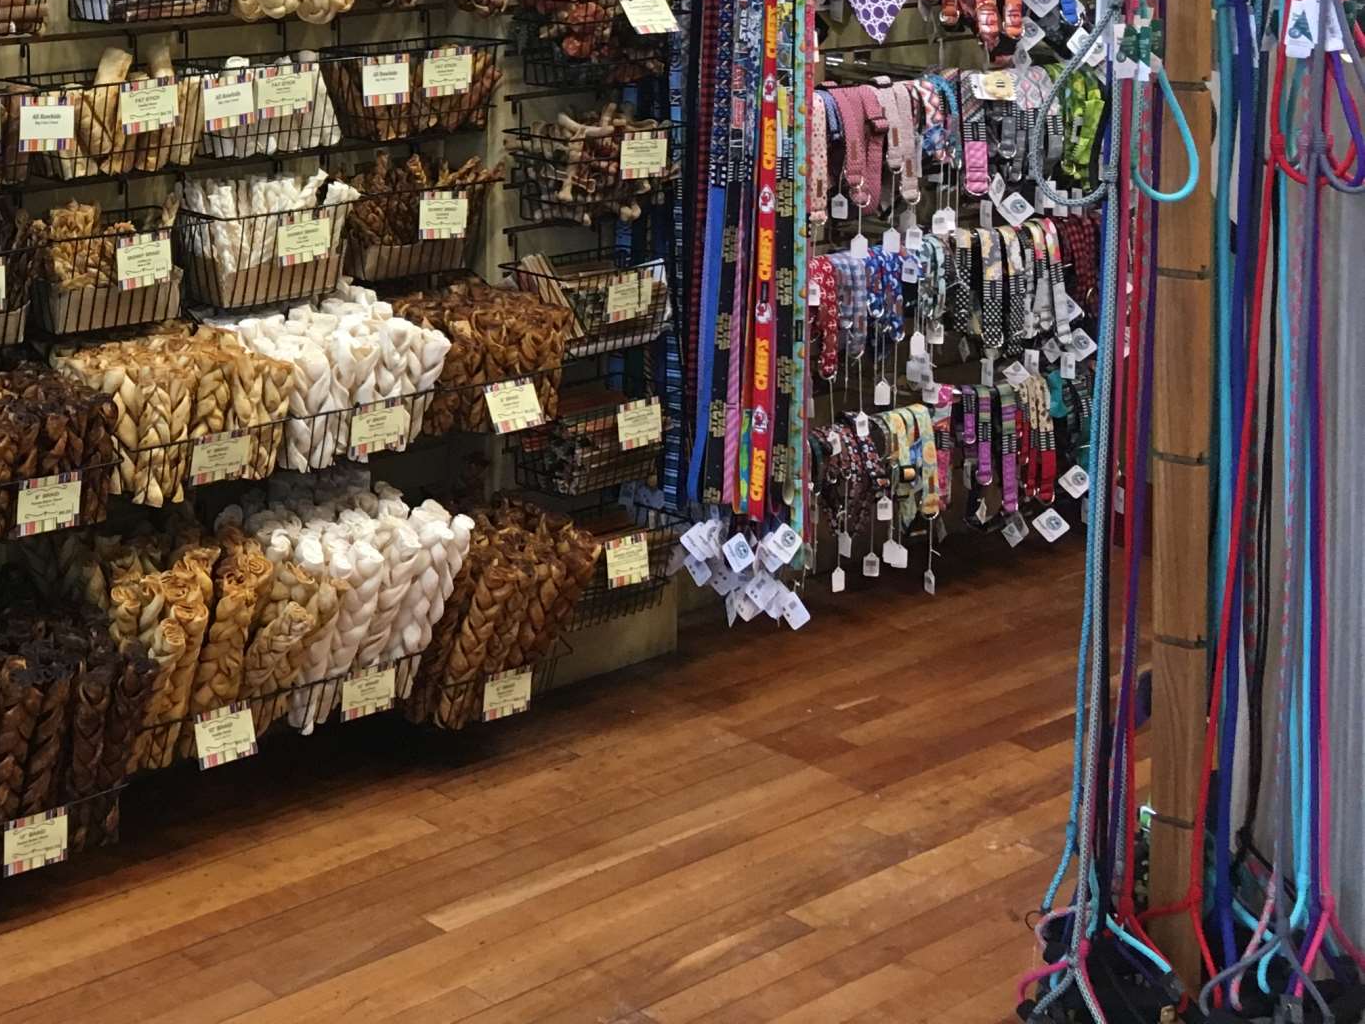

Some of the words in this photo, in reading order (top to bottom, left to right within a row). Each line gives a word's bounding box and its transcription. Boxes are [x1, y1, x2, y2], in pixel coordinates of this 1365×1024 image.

[765, 6, 776, 58] CHIEFS
[762, 117, 776, 170] CHIEFS
[757, 227, 773, 281] CHIEFS
[754, 337, 770, 391] CHIEFS
[750, 447, 766, 502] CHIEFS
